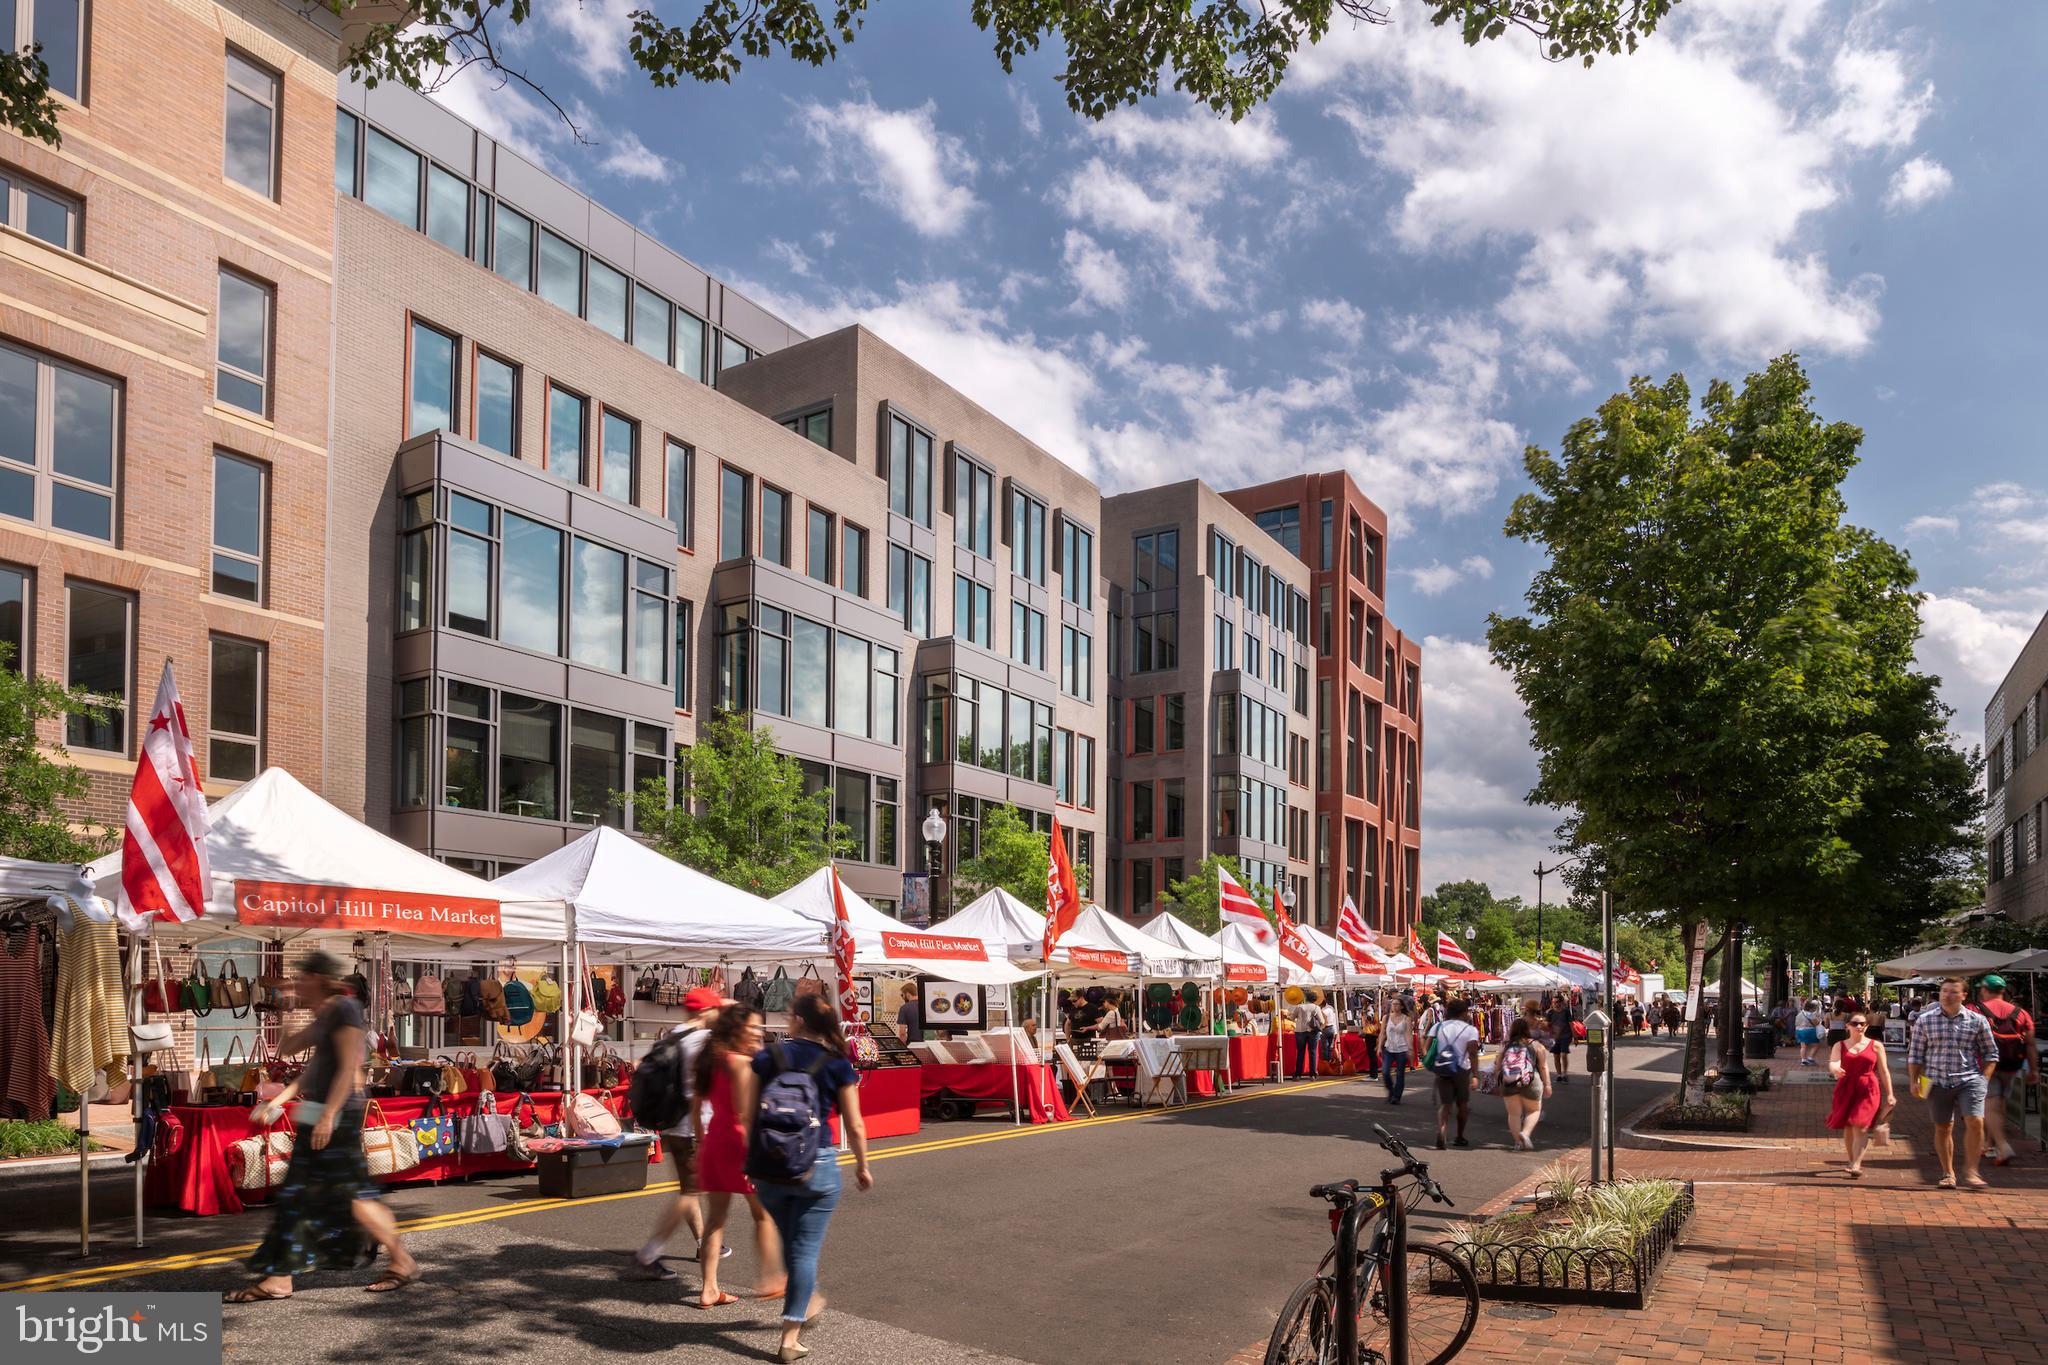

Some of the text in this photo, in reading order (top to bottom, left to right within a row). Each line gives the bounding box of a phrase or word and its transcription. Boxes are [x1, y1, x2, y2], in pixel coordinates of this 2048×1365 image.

[243, 894, 497, 926] Capitol Hill Flea Market
[888, 936, 981, 952] Capitol Hill Flea Market
